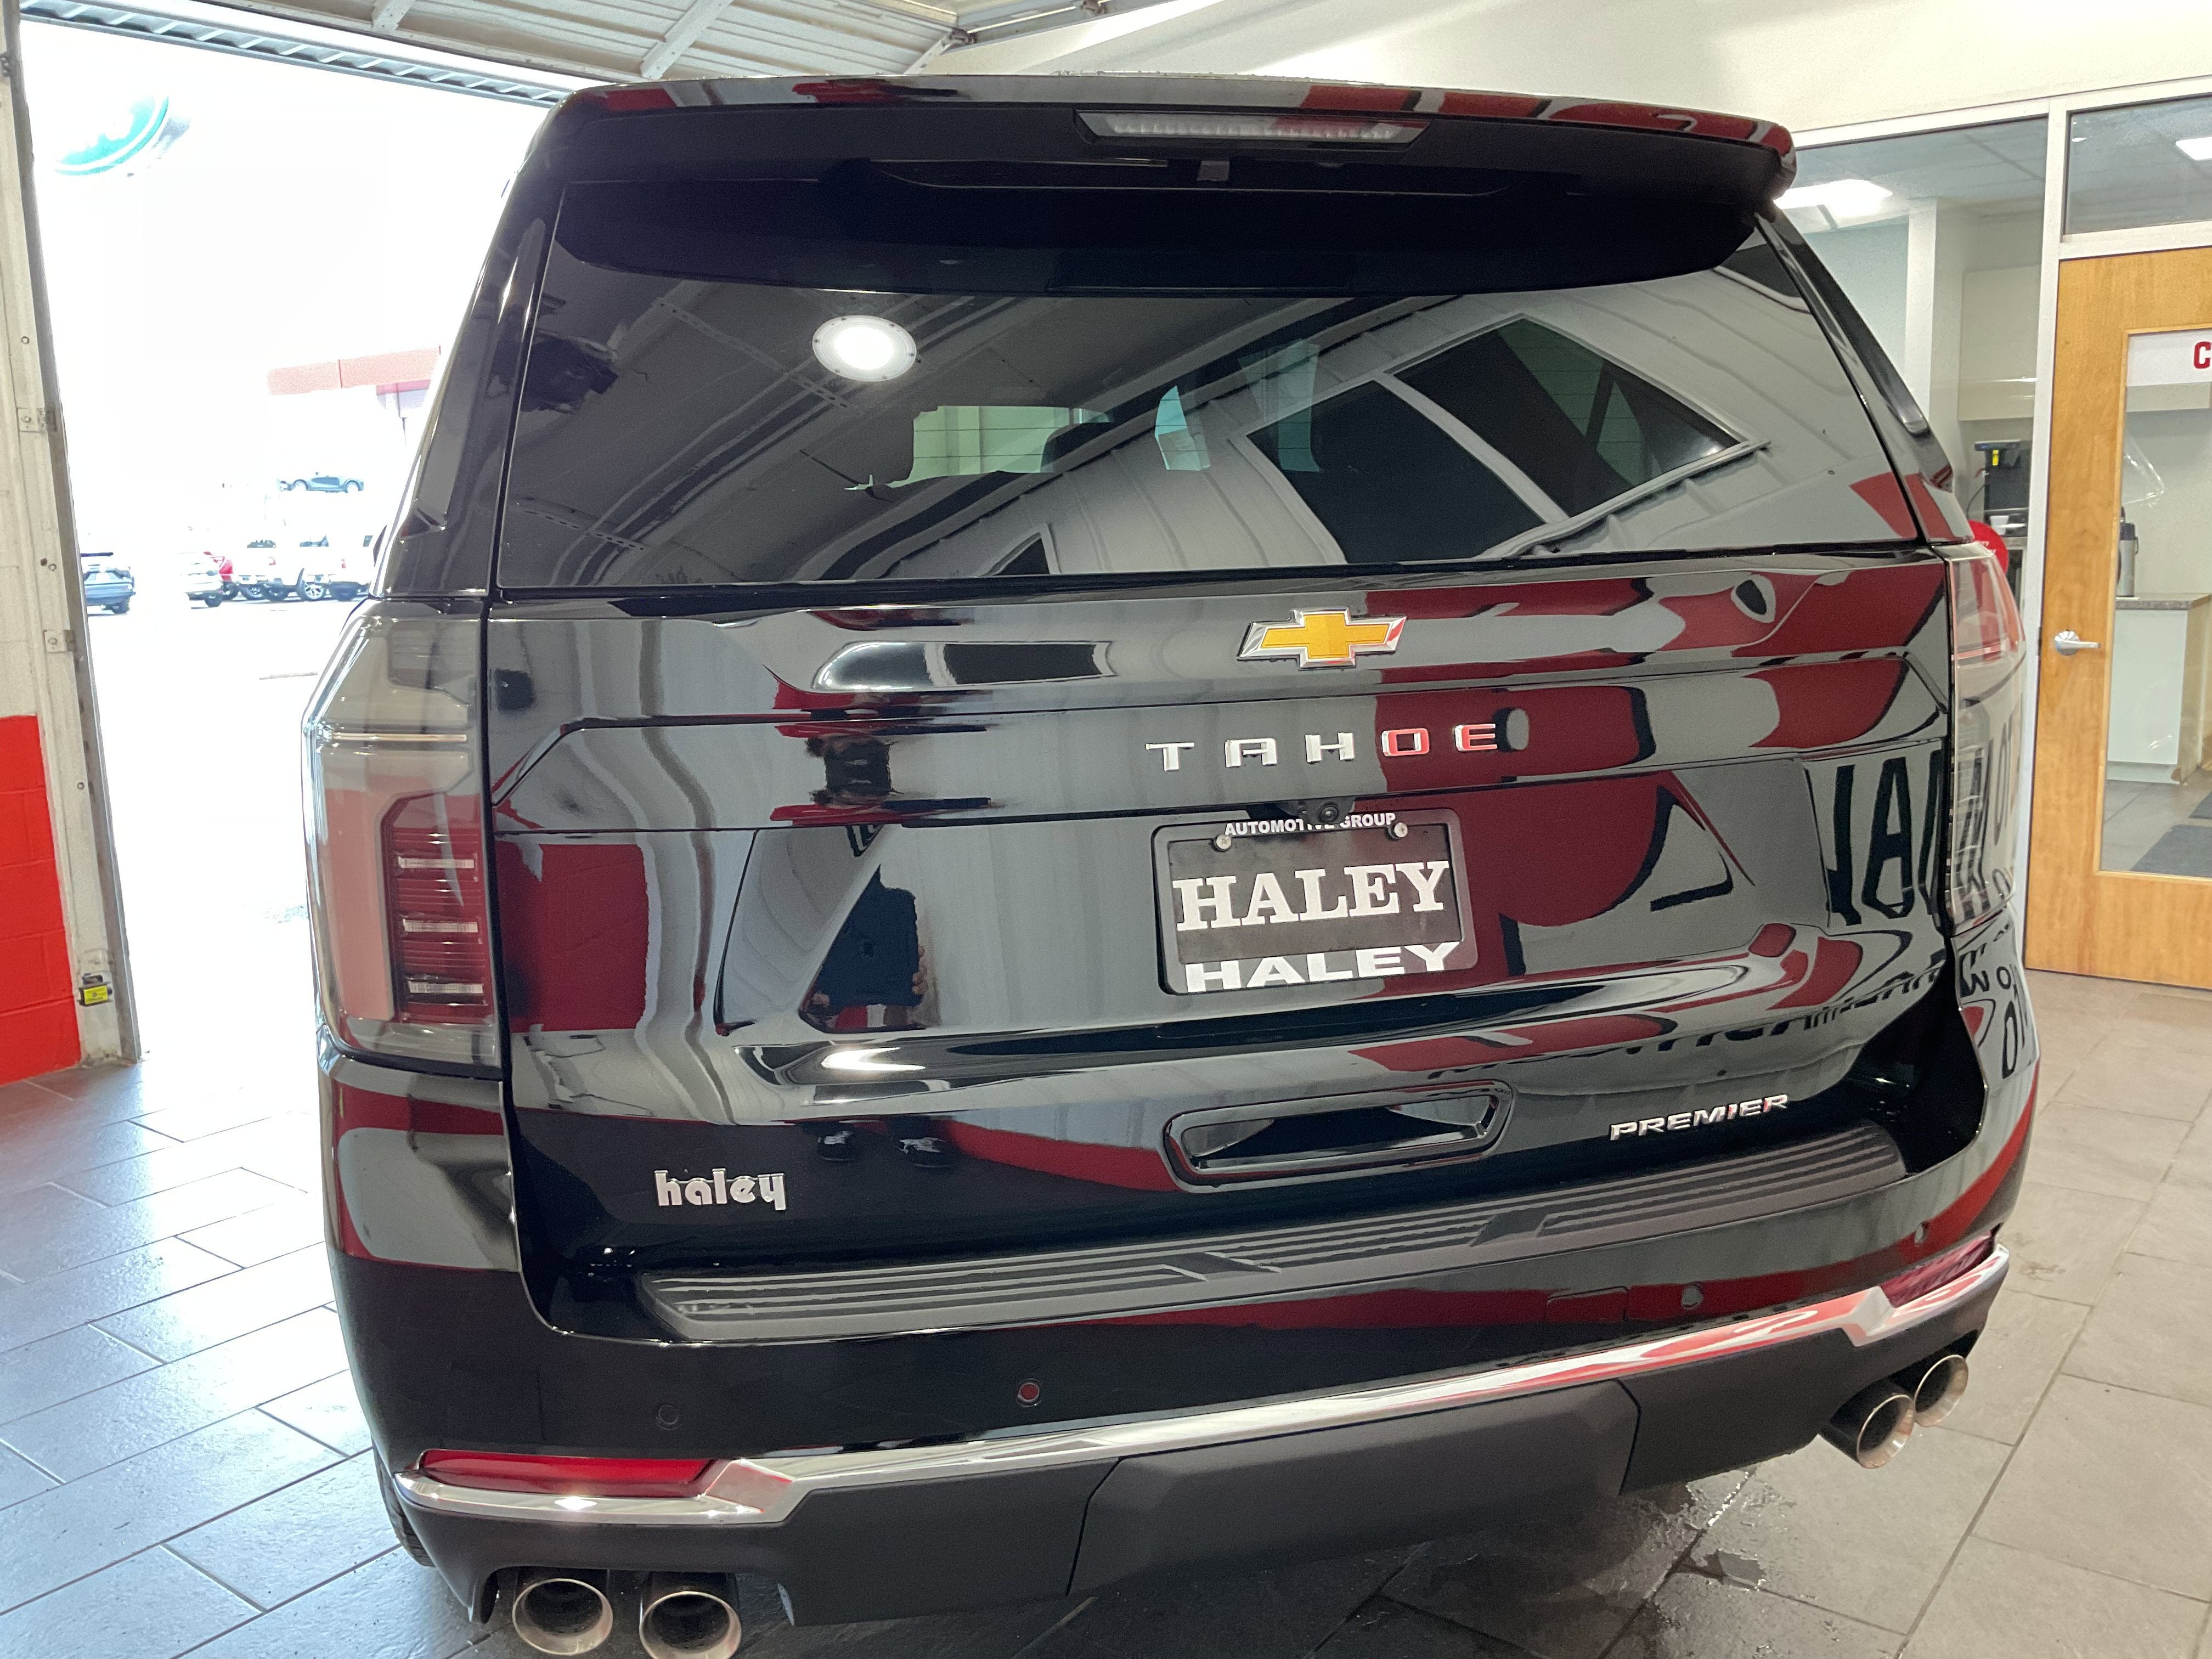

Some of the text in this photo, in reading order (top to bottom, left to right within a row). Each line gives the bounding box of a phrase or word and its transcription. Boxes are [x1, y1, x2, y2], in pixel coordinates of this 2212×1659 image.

[1146, 724, 1498, 771] TAHOE
[1339, 812, 1396, 828] GROUP
[1172, 860, 1450, 931] HALEY
[1185, 941, 1460, 993] HALEY
[1610, 1094, 1788, 1141] PREMIER
[654, 1168, 786, 1211] haley
